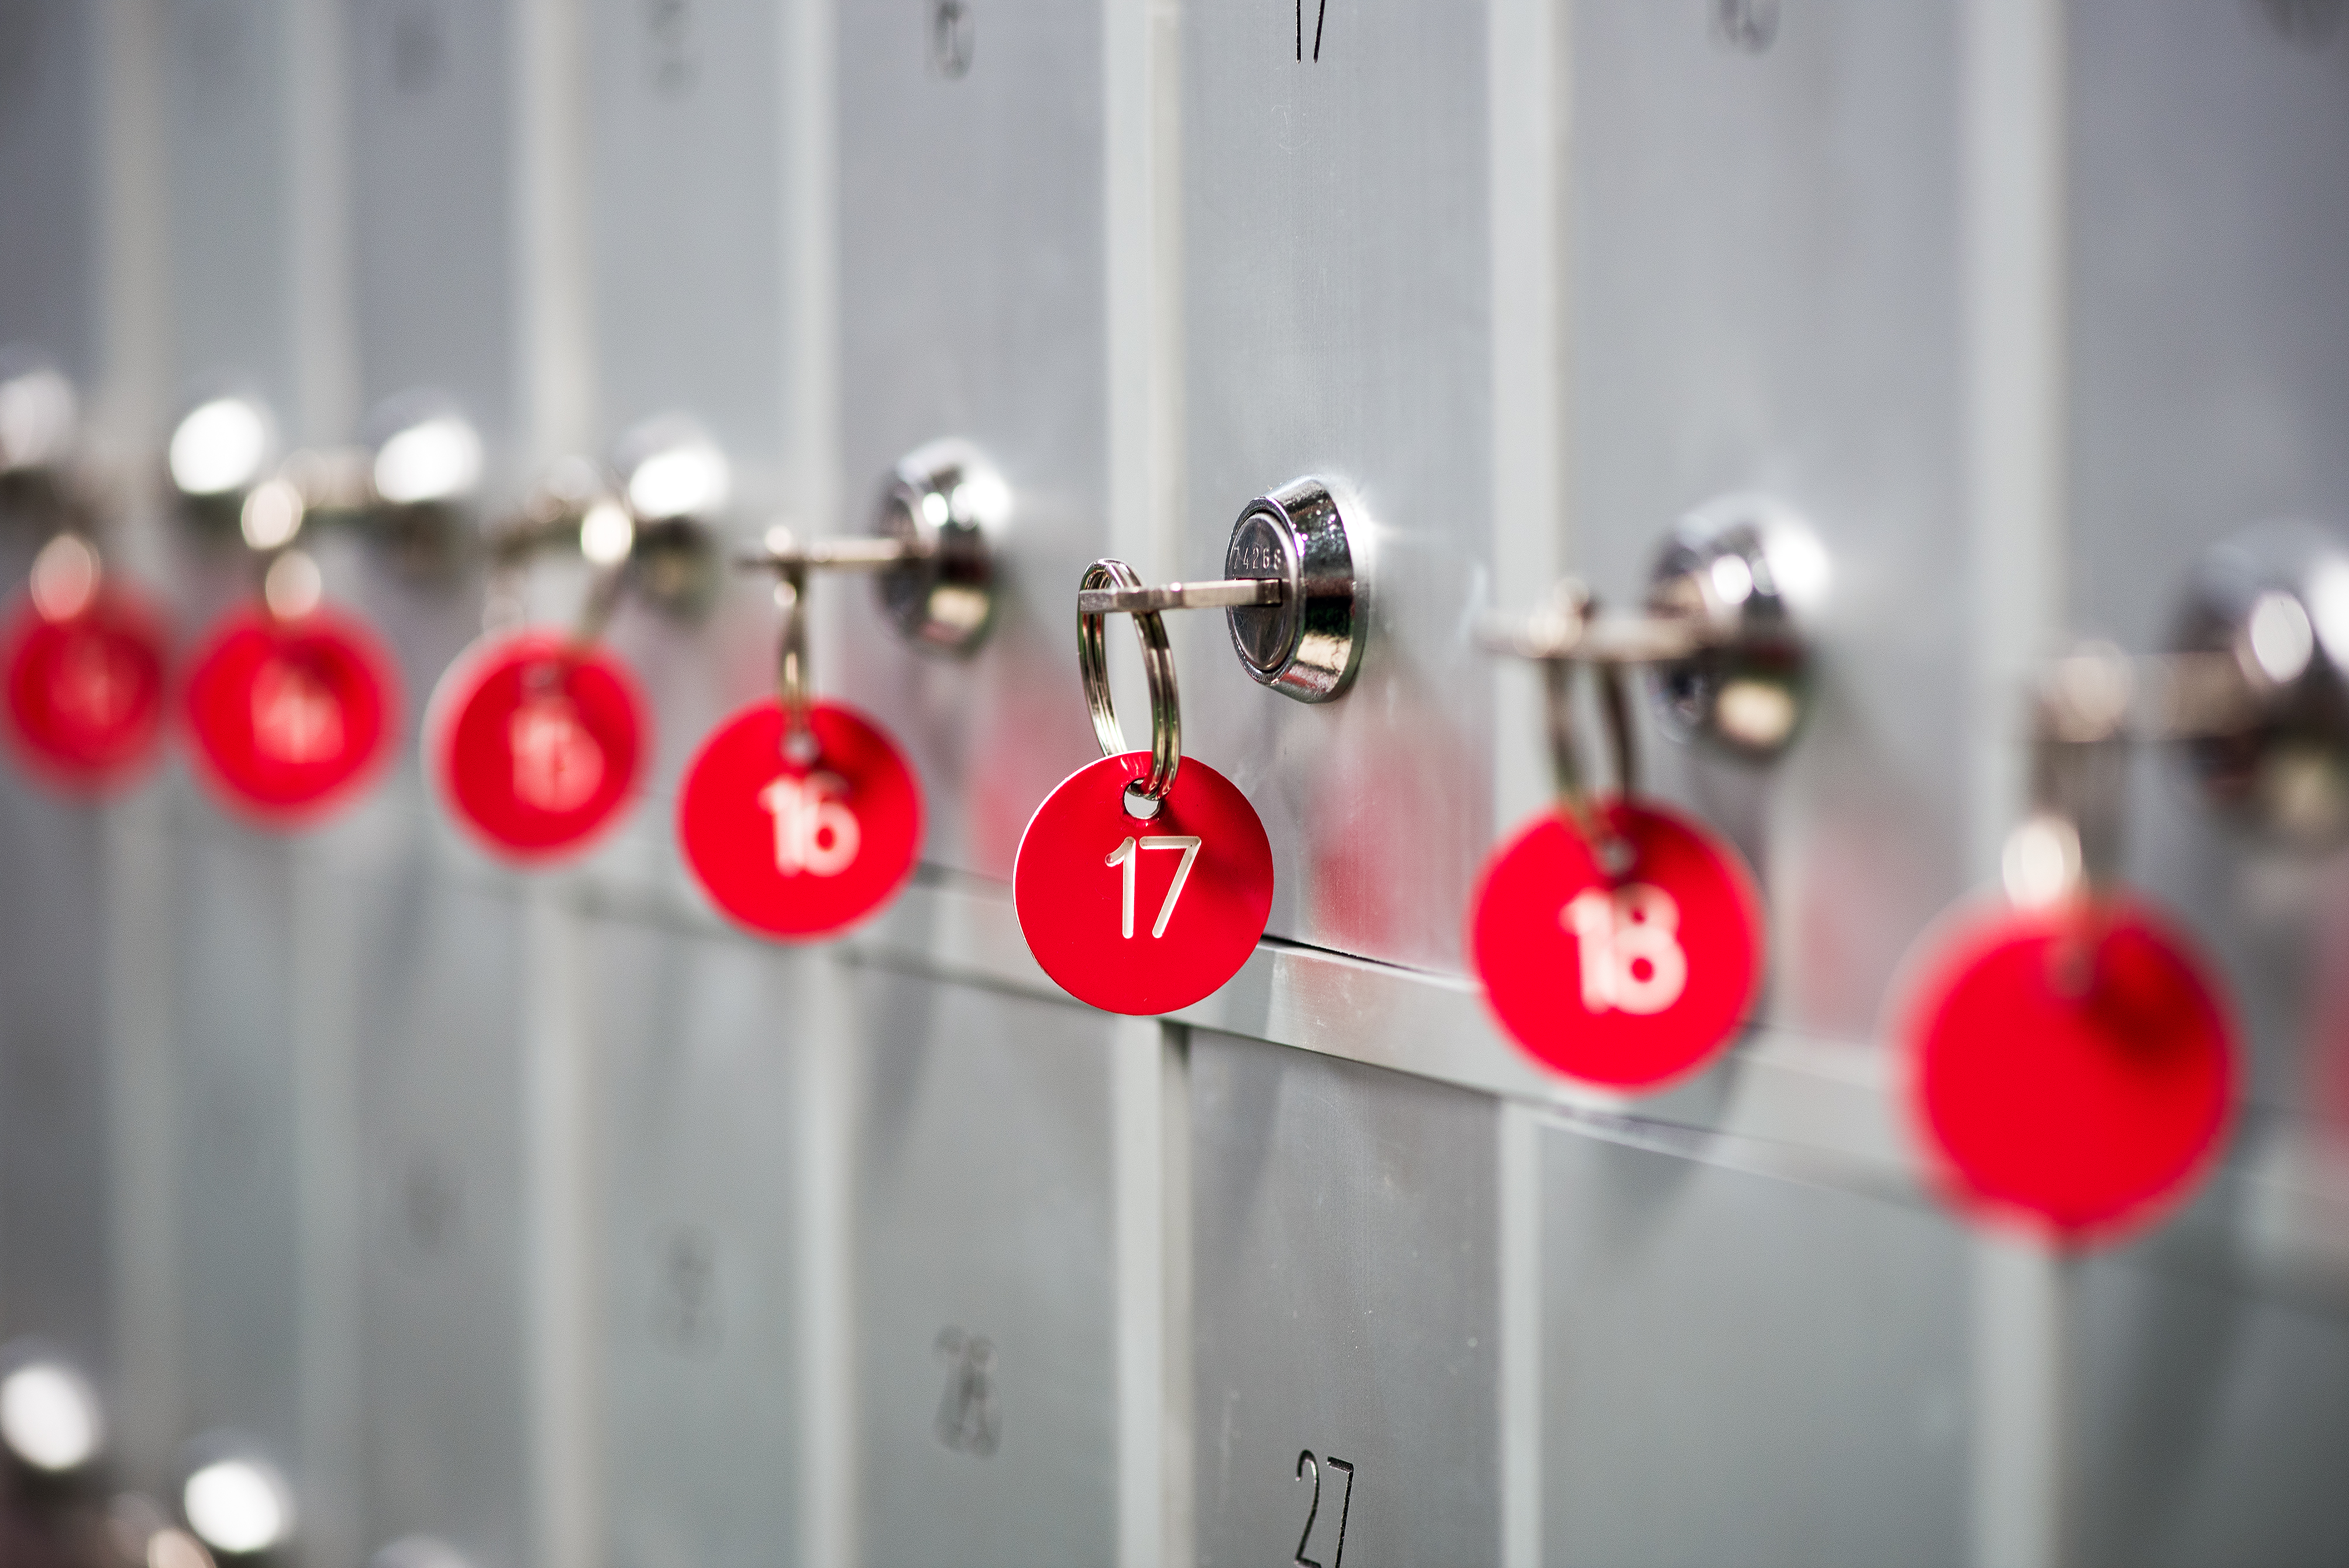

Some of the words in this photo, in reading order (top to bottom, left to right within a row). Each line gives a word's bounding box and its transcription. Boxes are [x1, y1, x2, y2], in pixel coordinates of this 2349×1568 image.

[758, 769, 861, 878] 16
[1105, 836, 1202, 939] 17
[1558, 881, 1689, 1016] 18
[1294, 1449, 1354, 1568] 27
